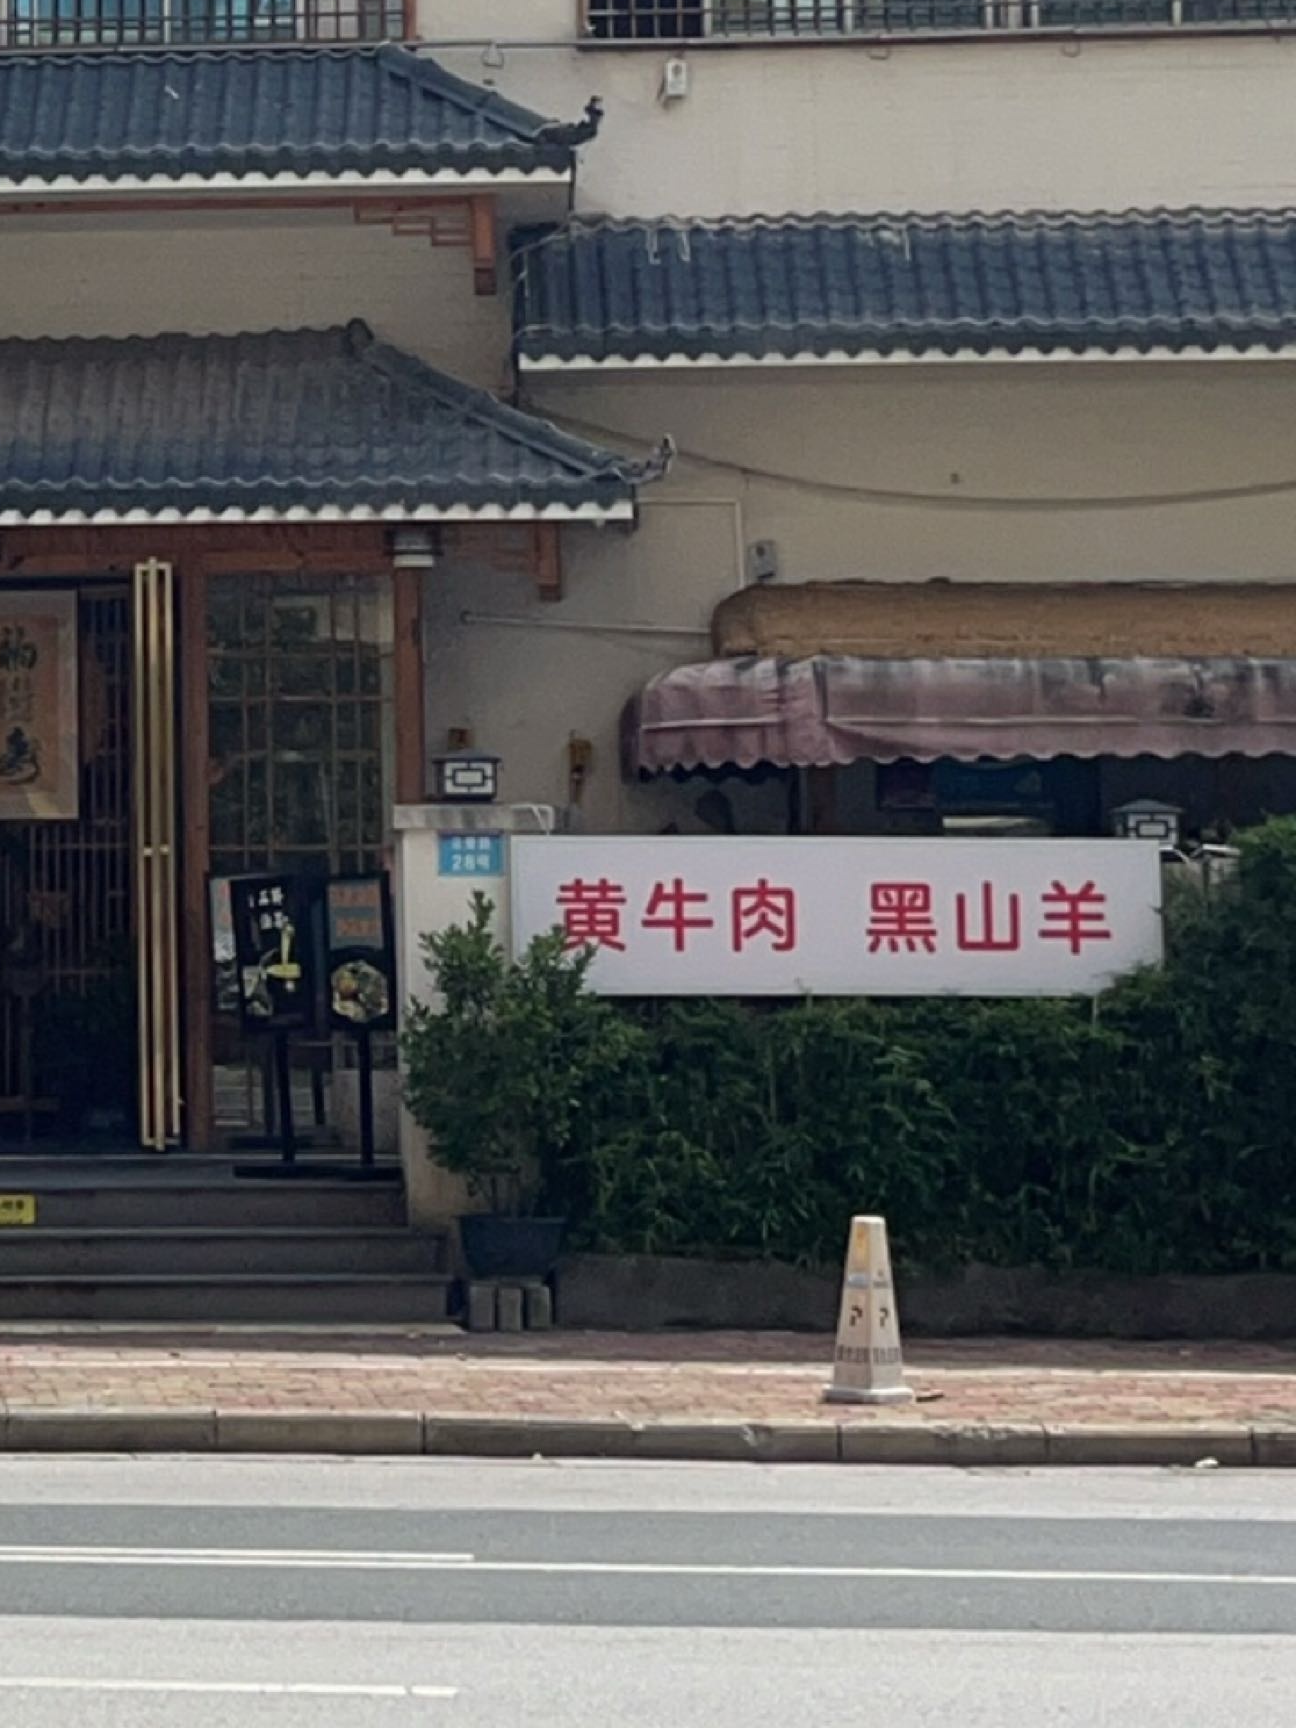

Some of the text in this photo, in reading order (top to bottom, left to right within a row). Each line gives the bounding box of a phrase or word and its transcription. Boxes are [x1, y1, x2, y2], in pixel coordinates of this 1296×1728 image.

[555, 878, 1112, 955] 黄牛肉 黑山羊
